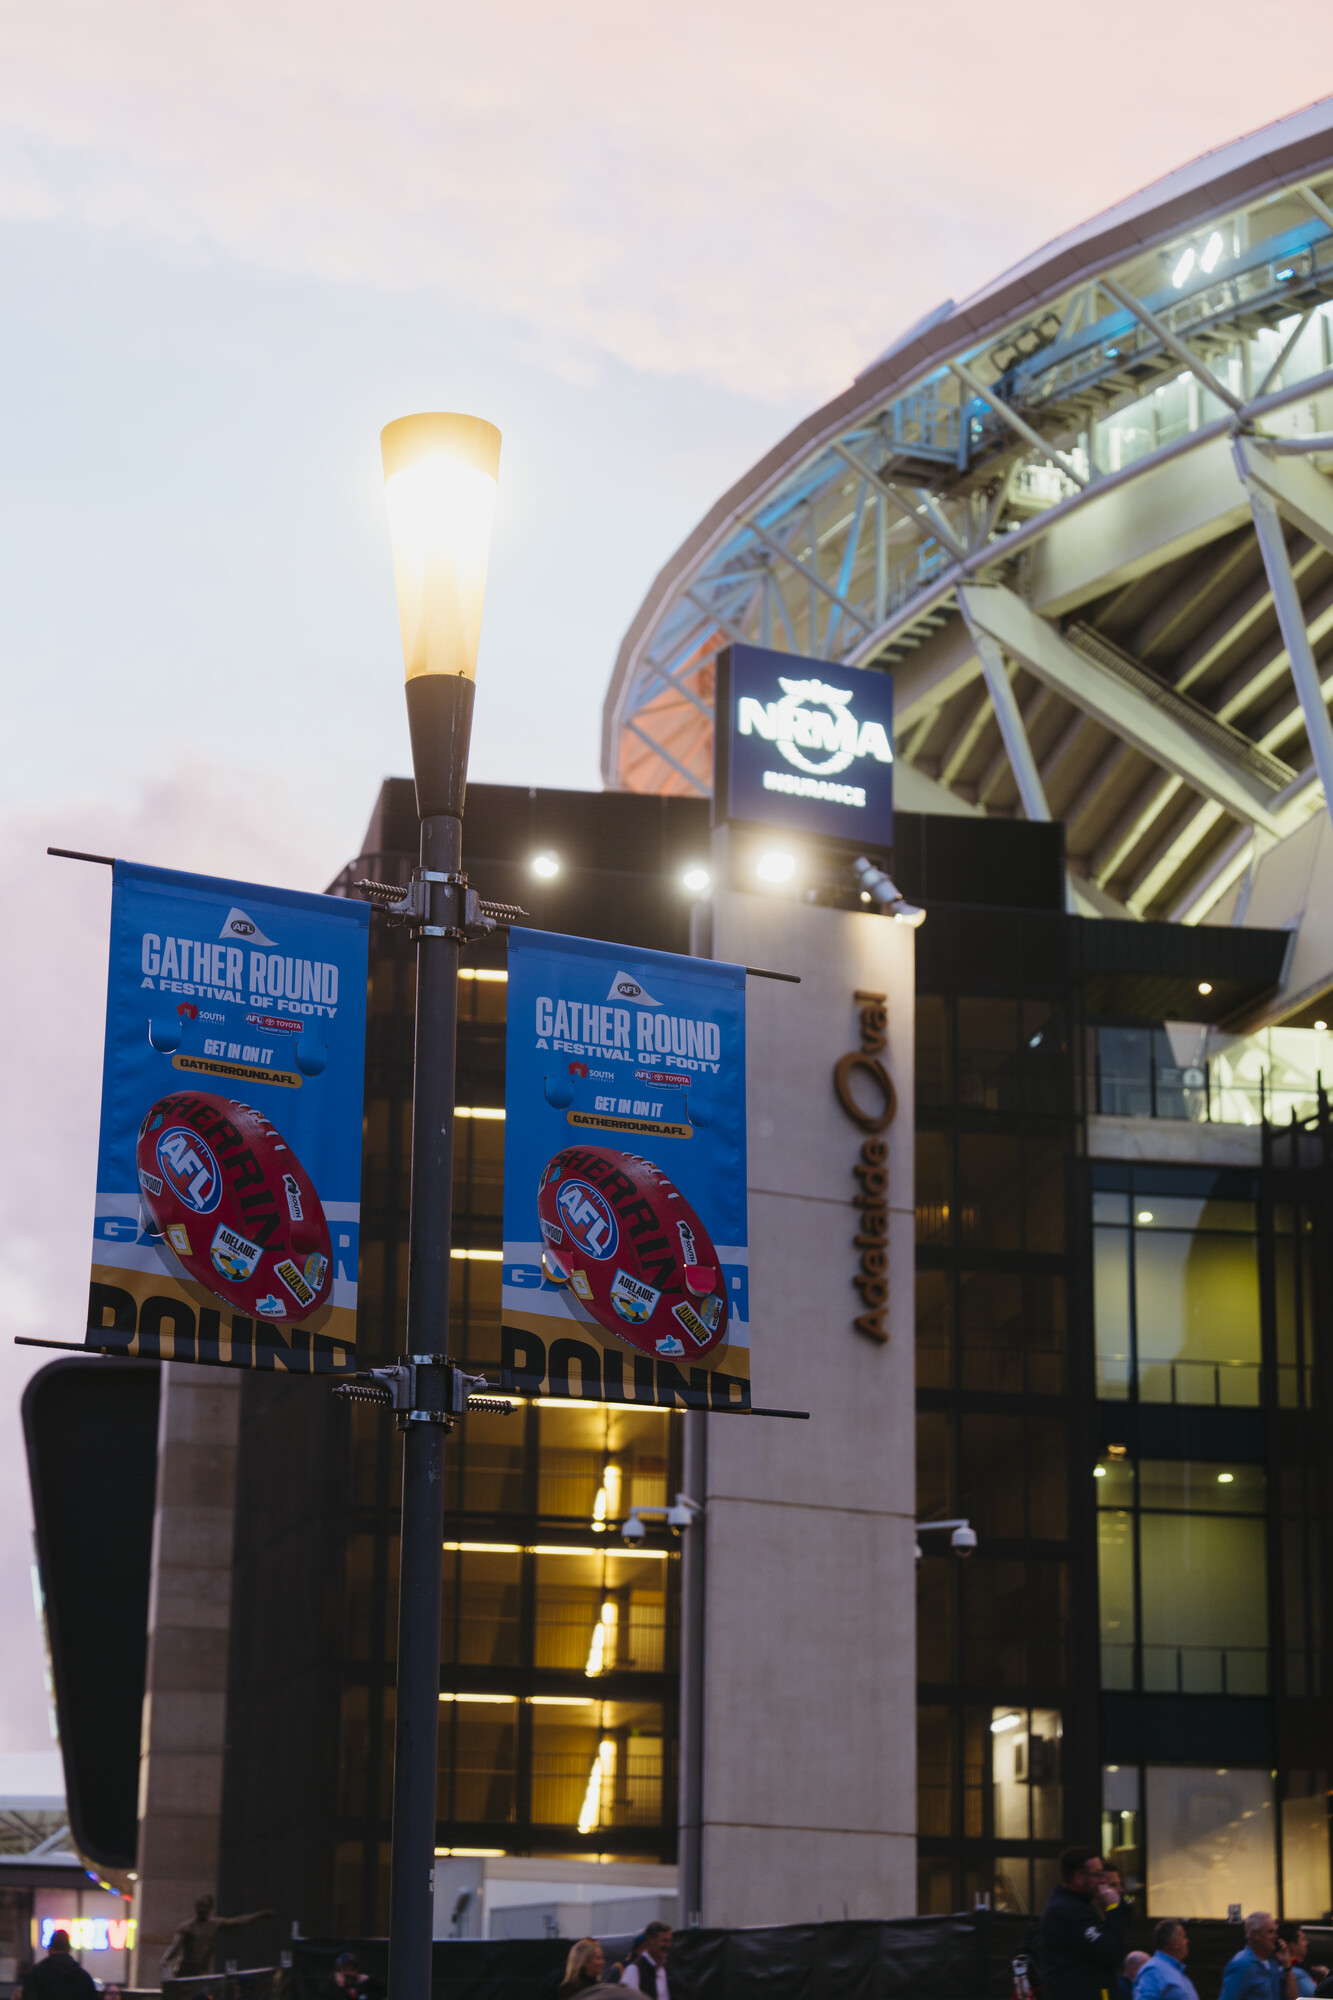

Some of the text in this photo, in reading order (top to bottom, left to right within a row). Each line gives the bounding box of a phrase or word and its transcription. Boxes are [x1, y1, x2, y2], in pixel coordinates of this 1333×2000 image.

[740, 697, 892, 762] NRMA
[233, 922, 254, 934] AFL
[141, 933, 339, 1005] GATHER ROUND
[141, 977, 338, 1019] A FESTIVAL OF FOOTY
[619, 985, 641, 996] AFL
[199, 1011, 226, 1022] SOUTH
[246, 1014, 302, 1030] AFL TOYOTA
[535, 996, 720, 1061] GATHER ROUND
[204, 1039, 274, 1064] GET IN ON IT
[535, 1038, 721, 1074] A FESTIVAL OF FOOTY
[180, 1058, 295, 1085] GATHERROUND.AFL
[589, 1069, 615, 1080] SOUTH
[634, 1071, 689, 1084] AFL TOYOTA
[594, 1096, 663, 1118] GET IN ON IT
[573, 1115, 686, 1135] GATHERROUND.AFL
[151, 1096, 286, 1252] SHERRIN
[159, 1134, 213, 1209] AFL
[833, 989, 898, 1349] Adelaide Oval
[291, 1194, 301, 1218] SOUTH
[559, 1186, 609, 1256] AFL
[550, 1151, 682, 1295] SHERRIN
[219, 1230, 257, 1260] ADELAIDE
[686, 1240, 695, 1263] SOUTH
[277, 1262, 313, 1305] ADELAIDE
[618, 1274, 655, 1303] ADELAIDE
[84, 1281, 356, 1375] ROUND
[675, 1303, 710, 1345] ADELAIDE
[502, 1325, 751, 1409] ROUND
